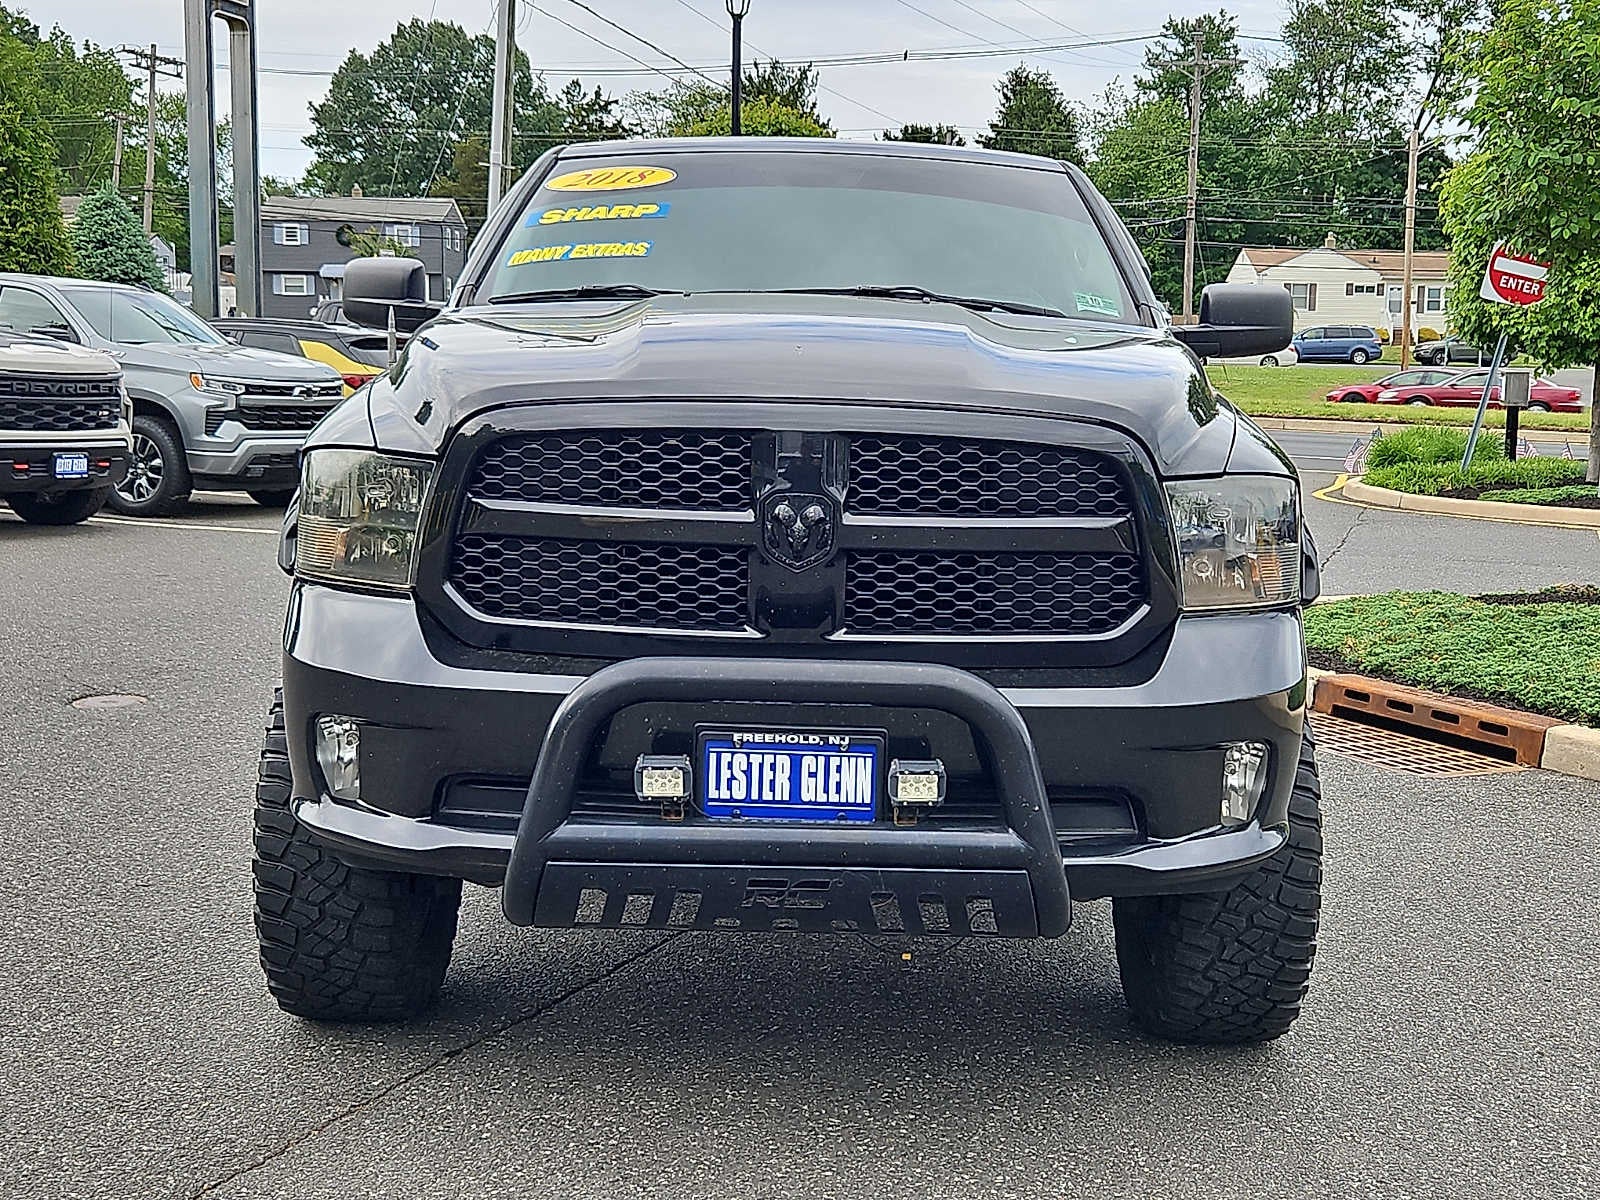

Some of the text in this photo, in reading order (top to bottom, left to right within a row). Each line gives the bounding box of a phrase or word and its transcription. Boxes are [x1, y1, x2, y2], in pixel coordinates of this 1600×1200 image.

[562, 169, 656, 188] 2018
[538, 203, 660, 225] SHARP
[507, 242, 651, 267] MANY EXTRAS
[1499, 275, 1540, 296] ENTER
[733, 733, 850, 746] FREEHOLD, NJ
[708, 752, 873, 804] LESTER GLENN
[741, 877, 833, 909] RC
